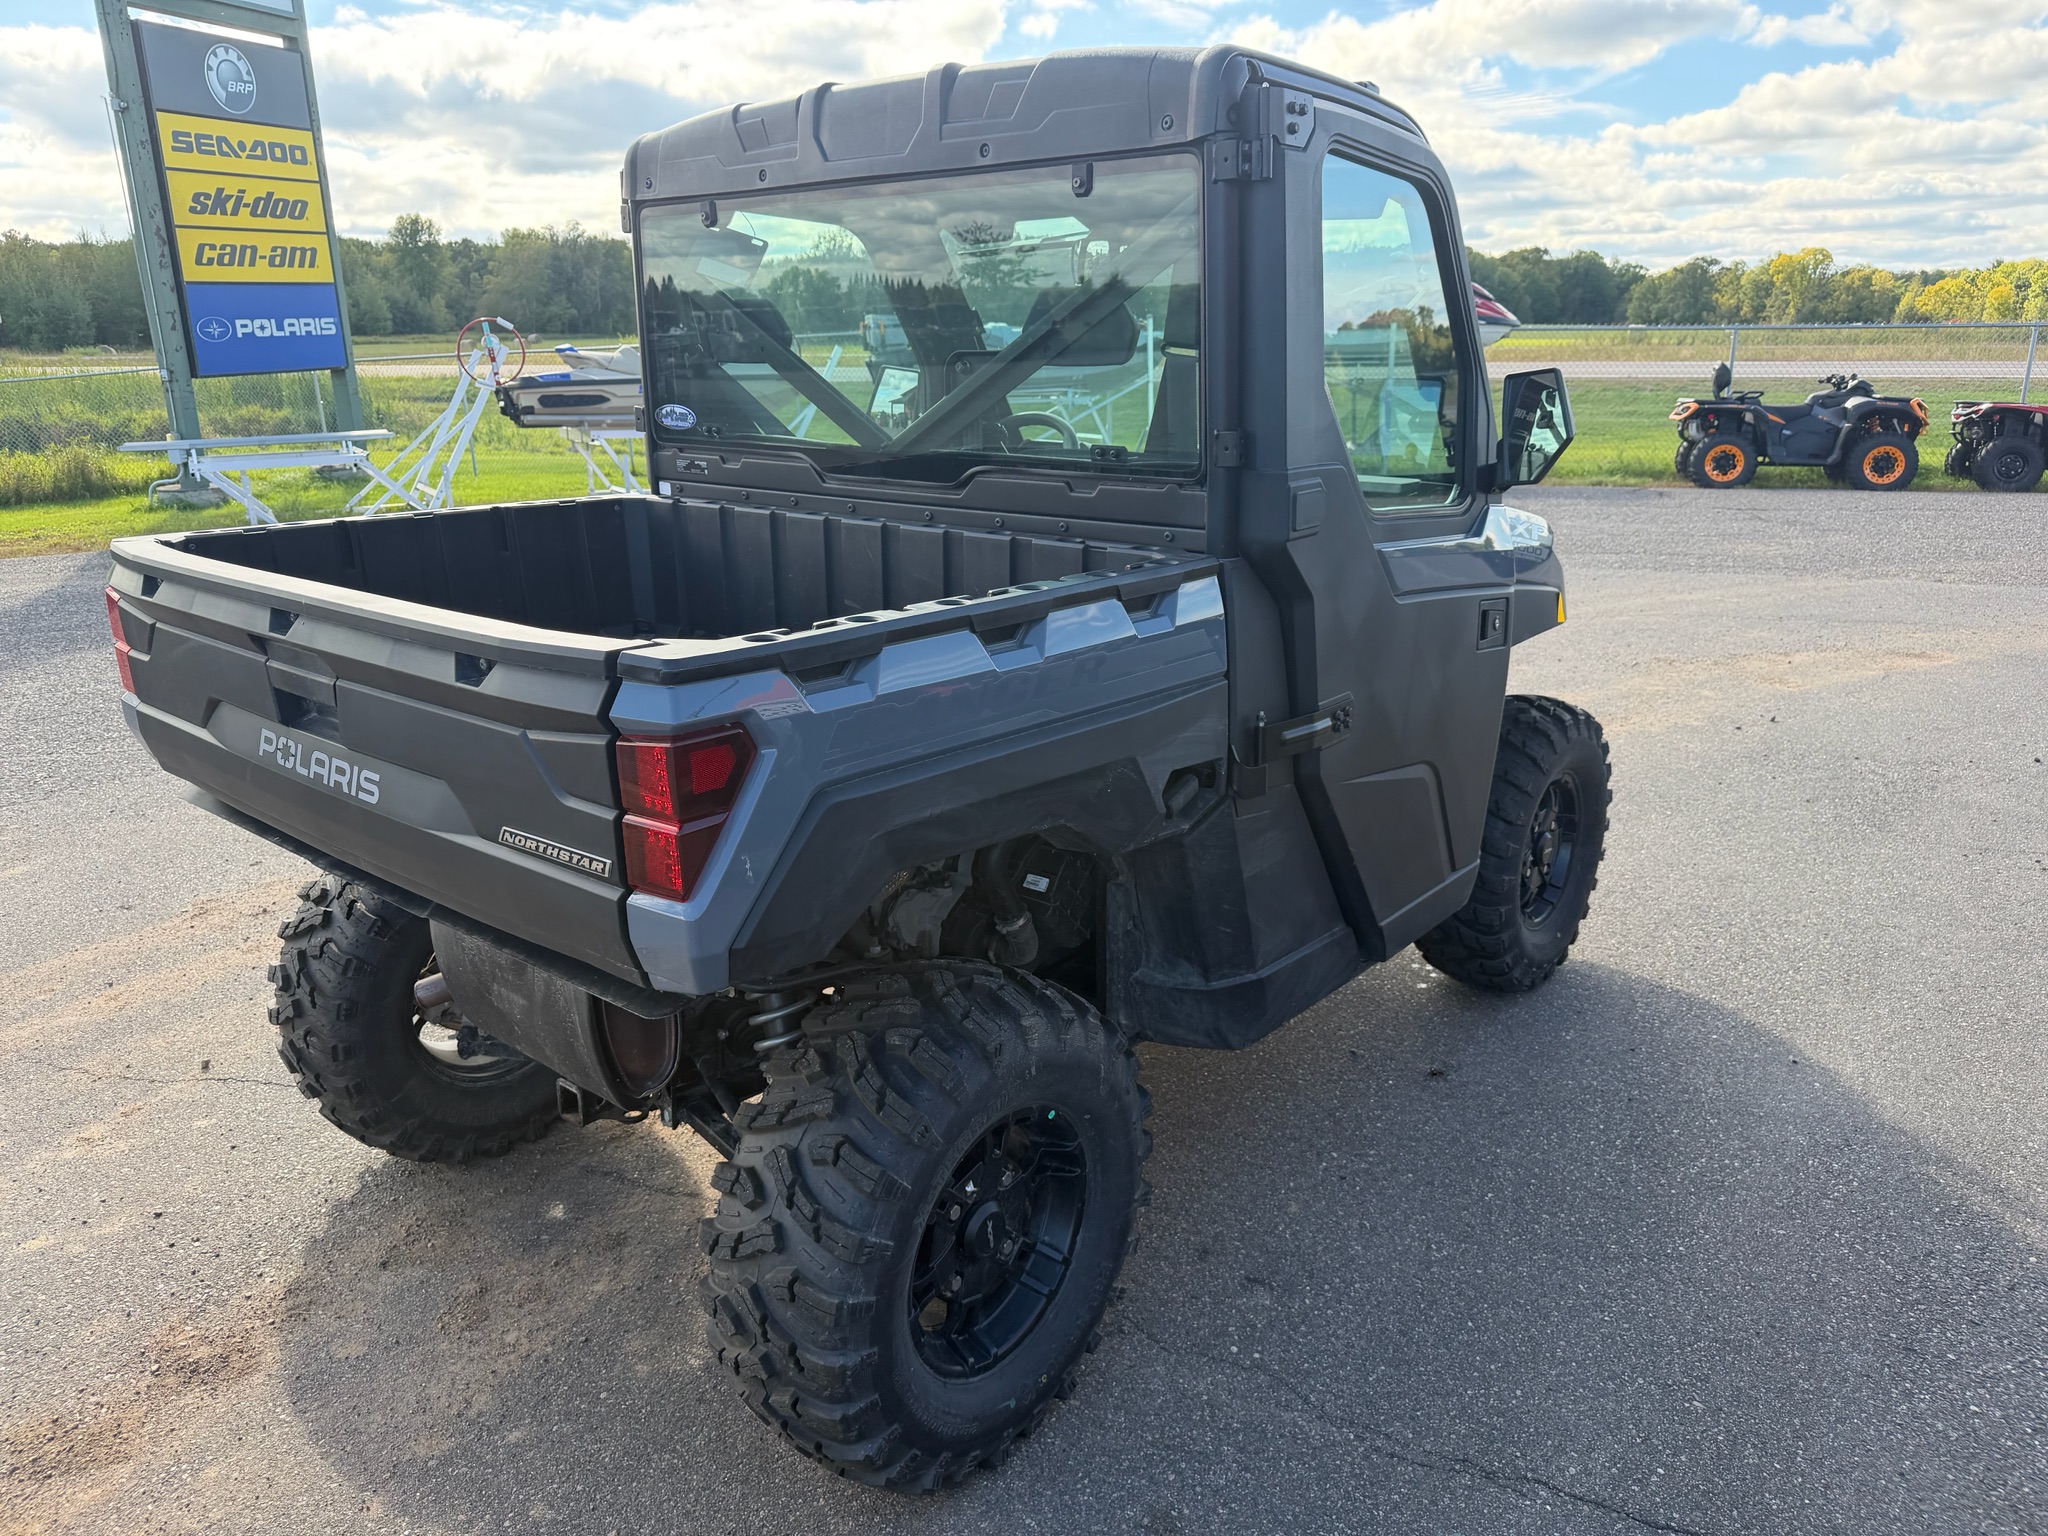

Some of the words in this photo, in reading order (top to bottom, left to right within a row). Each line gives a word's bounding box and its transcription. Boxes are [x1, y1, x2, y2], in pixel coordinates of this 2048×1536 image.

[227, 80, 254, 95] BRP
[188, 187, 309, 221] ski-doo
[194, 242, 317, 269] can-am
[235, 317, 337, 338] POLARIS
[1509, 516, 1549, 541] XP
[258, 728, 381, 805] POLARIS
[502, 830, 605, 874] NORTHSTAR
